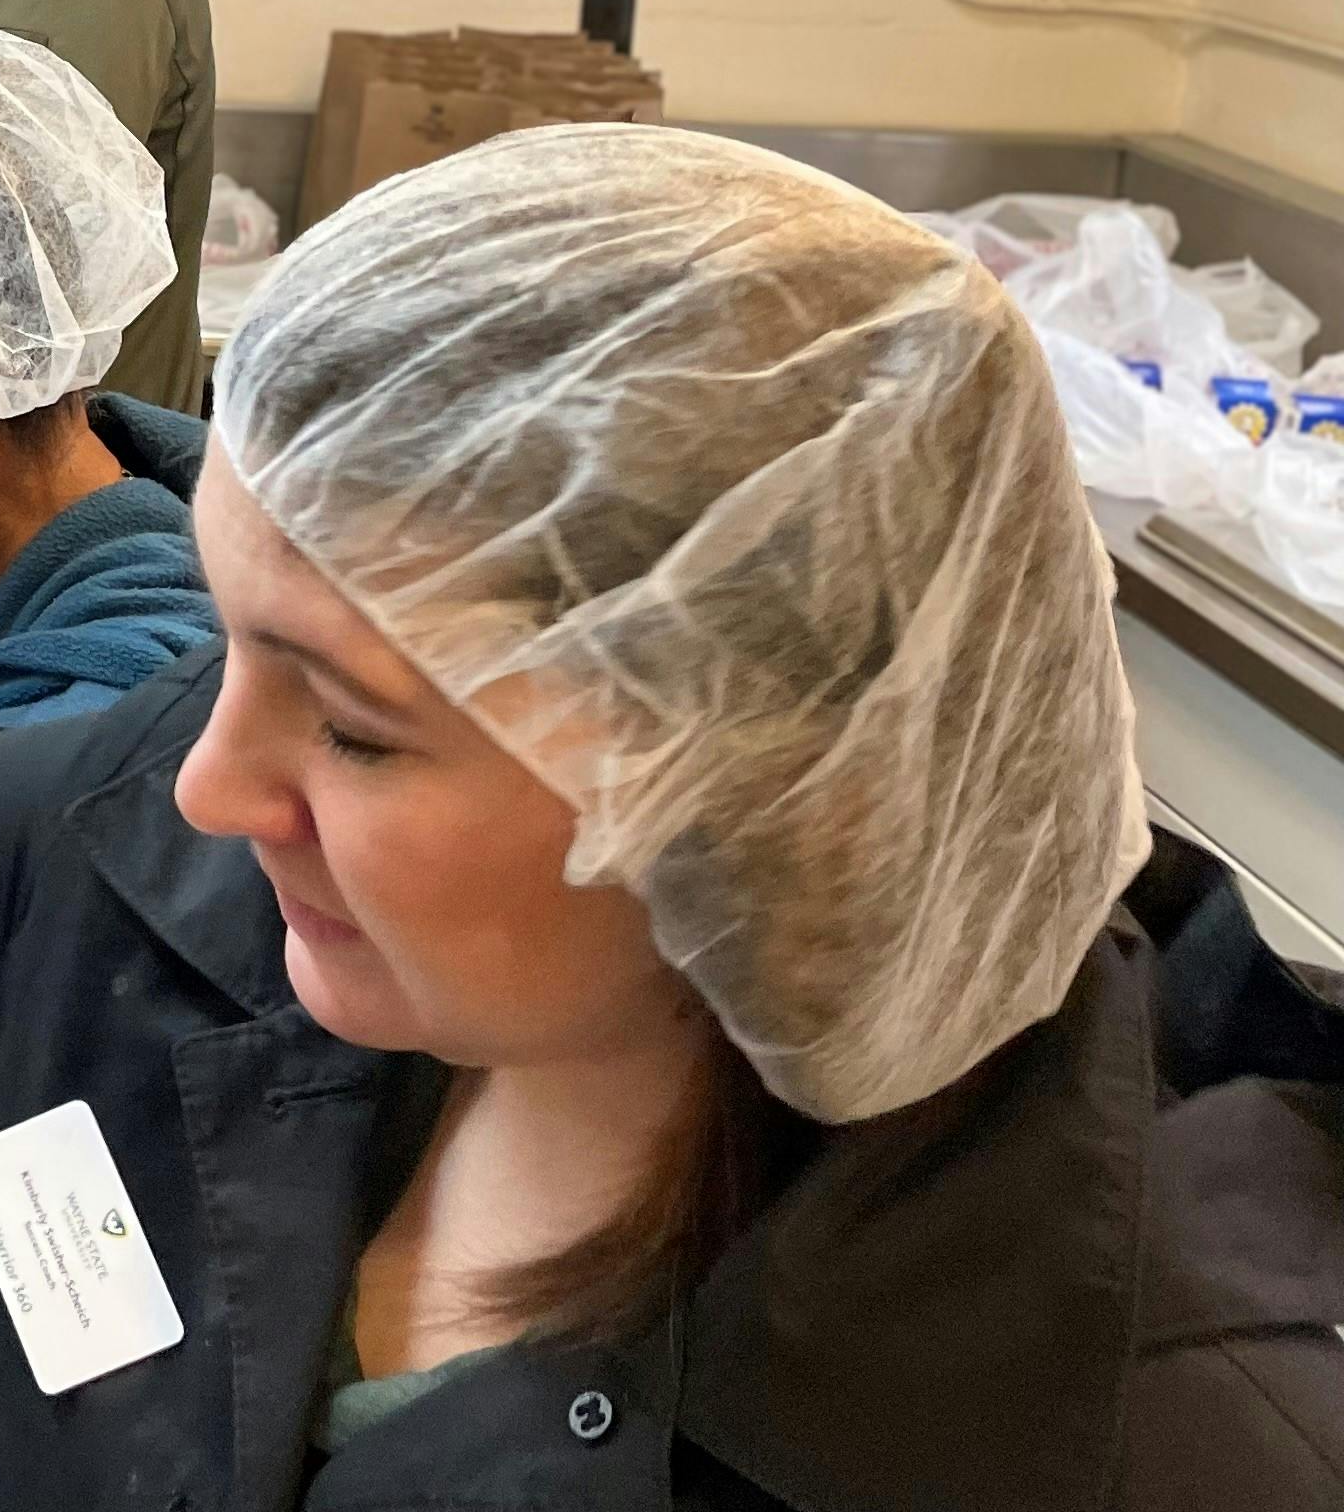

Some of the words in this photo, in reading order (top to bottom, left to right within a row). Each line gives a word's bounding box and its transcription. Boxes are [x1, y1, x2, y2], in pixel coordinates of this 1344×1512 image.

[21, 1170, 48, 1226] Kimberly
[43, 1228, 90, 1329] Swisher-Scheich
[62, 1209, 92, 1272] UNIVERSITY
[66, 1191, 91, 1242] WAYNE
[86, 1239, 109, 1281] STATE
[13, 1284, 32, 1313] 360
